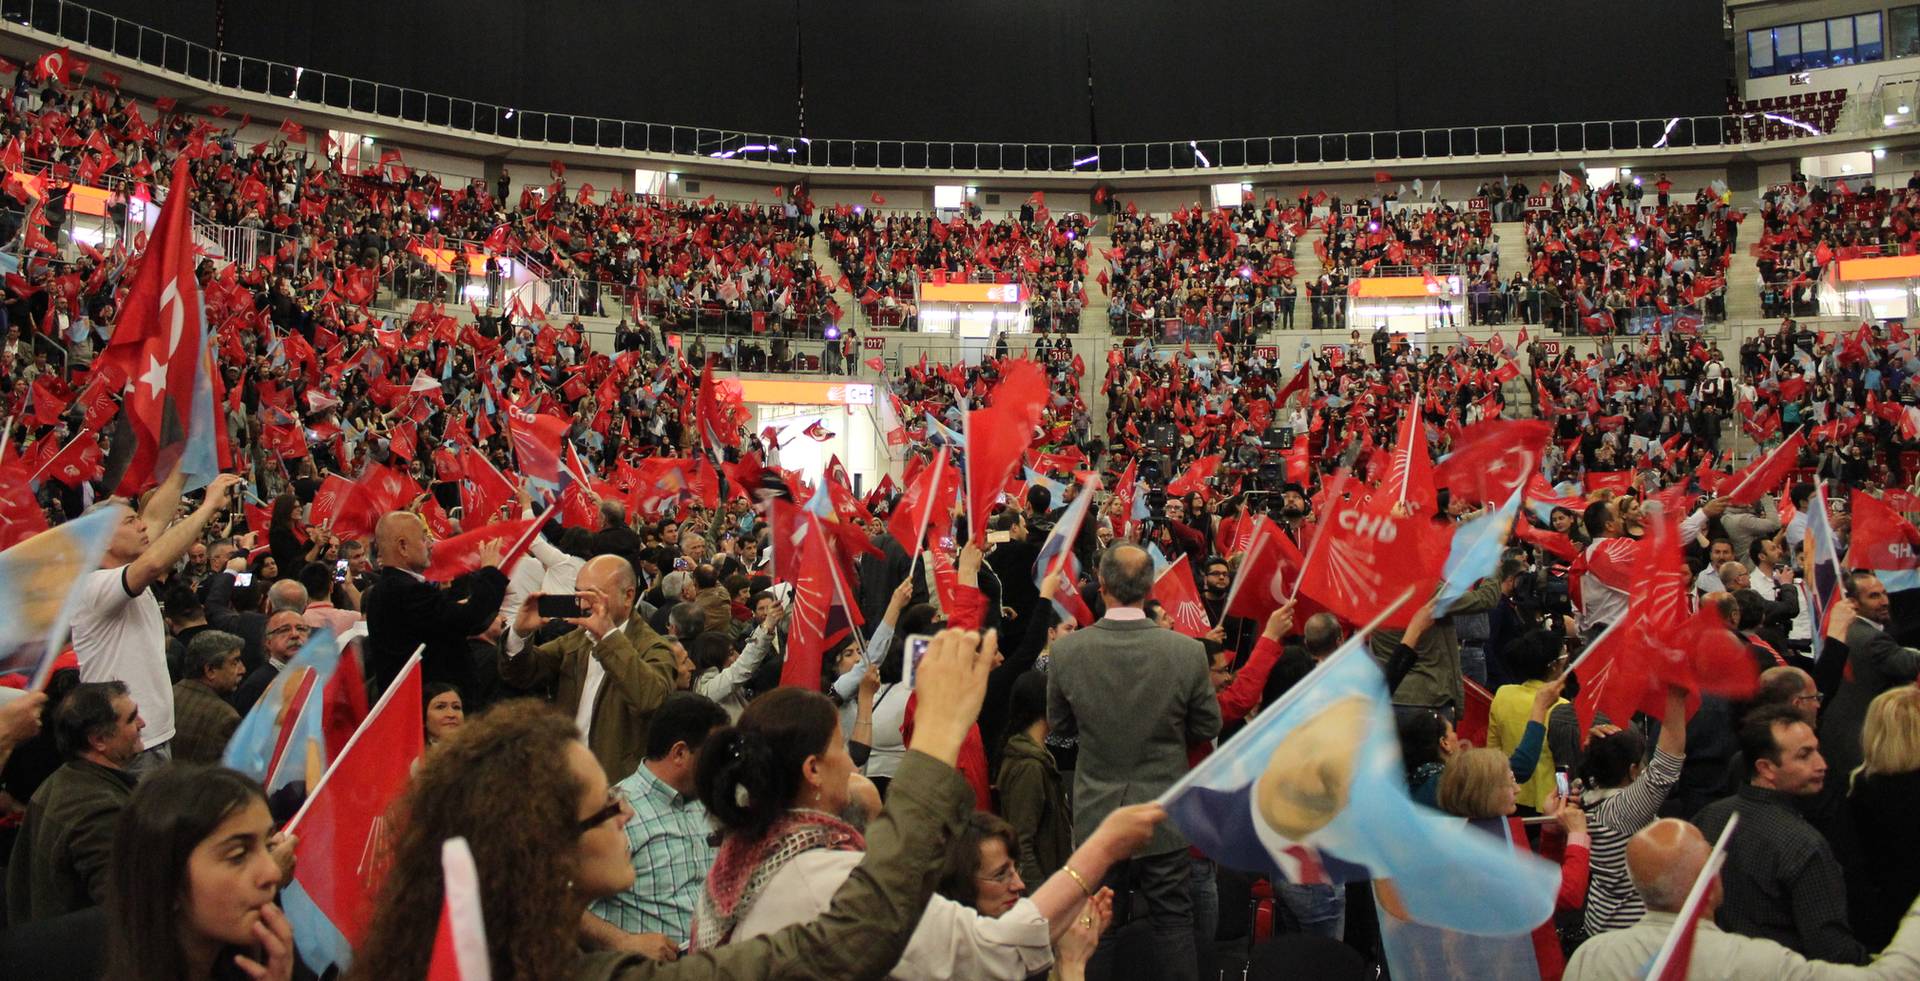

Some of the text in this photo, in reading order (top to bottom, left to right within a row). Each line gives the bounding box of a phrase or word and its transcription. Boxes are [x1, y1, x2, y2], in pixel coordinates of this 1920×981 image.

[1471, 200, 1484, 208] 121
[1530, 198, 1543, 206] 121
[867, 338, 883, 348] 017
[1339, 509, 1398, 543] CHP
